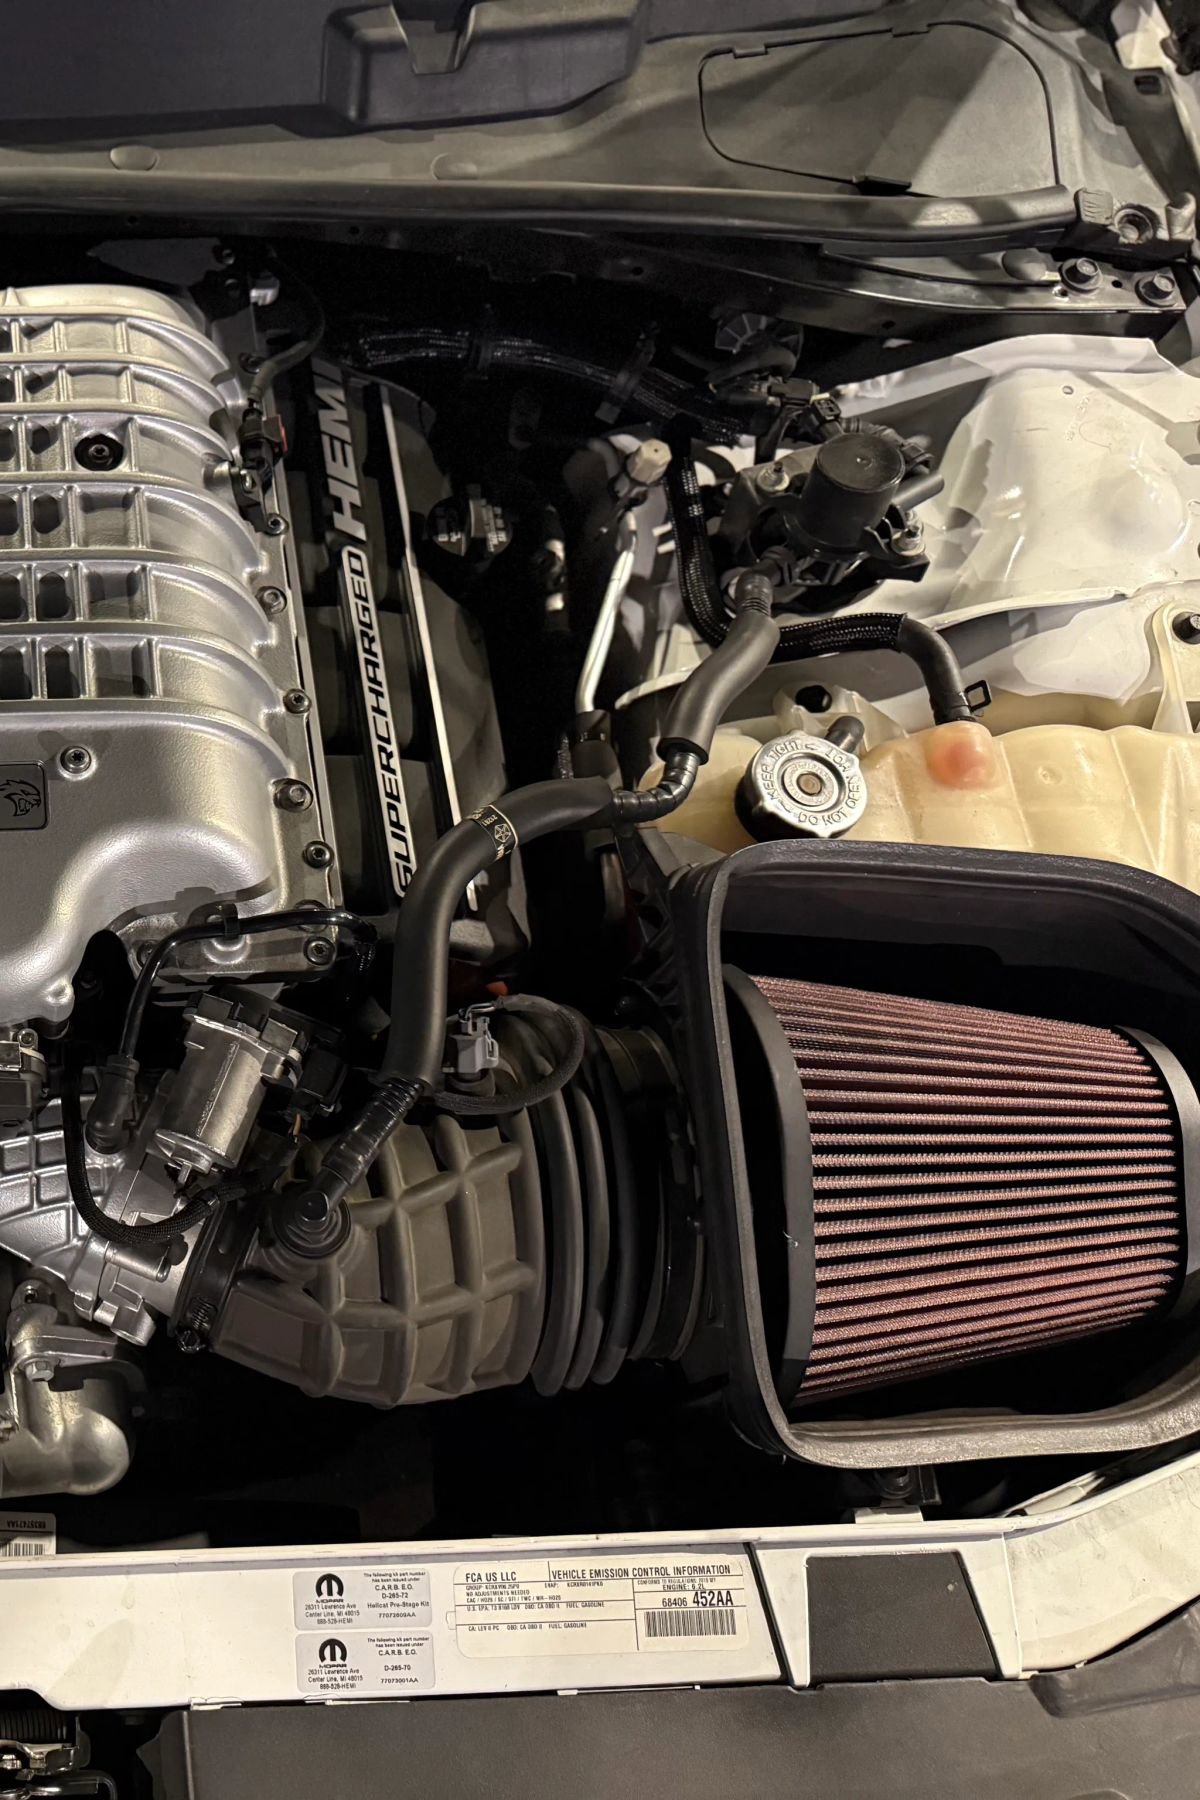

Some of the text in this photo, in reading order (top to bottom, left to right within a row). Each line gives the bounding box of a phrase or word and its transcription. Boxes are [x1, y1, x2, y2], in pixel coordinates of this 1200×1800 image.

[312, 356, 416, 894] SUPERCHARGED HEMI
[761, 764, 778, 800] KEEP
[798, 811, 819, 826] DO
[821, 806, 847, 826] NOT
[845, 775, 860, 809] OPEN
[465, 1571, 517, 1582] FCA US LLC
[552, 1565, 731, 1580] VEHICLE EMISSION CONTROL INFORMATION
[661, 1590, 734, 1608] 68406 452AA
